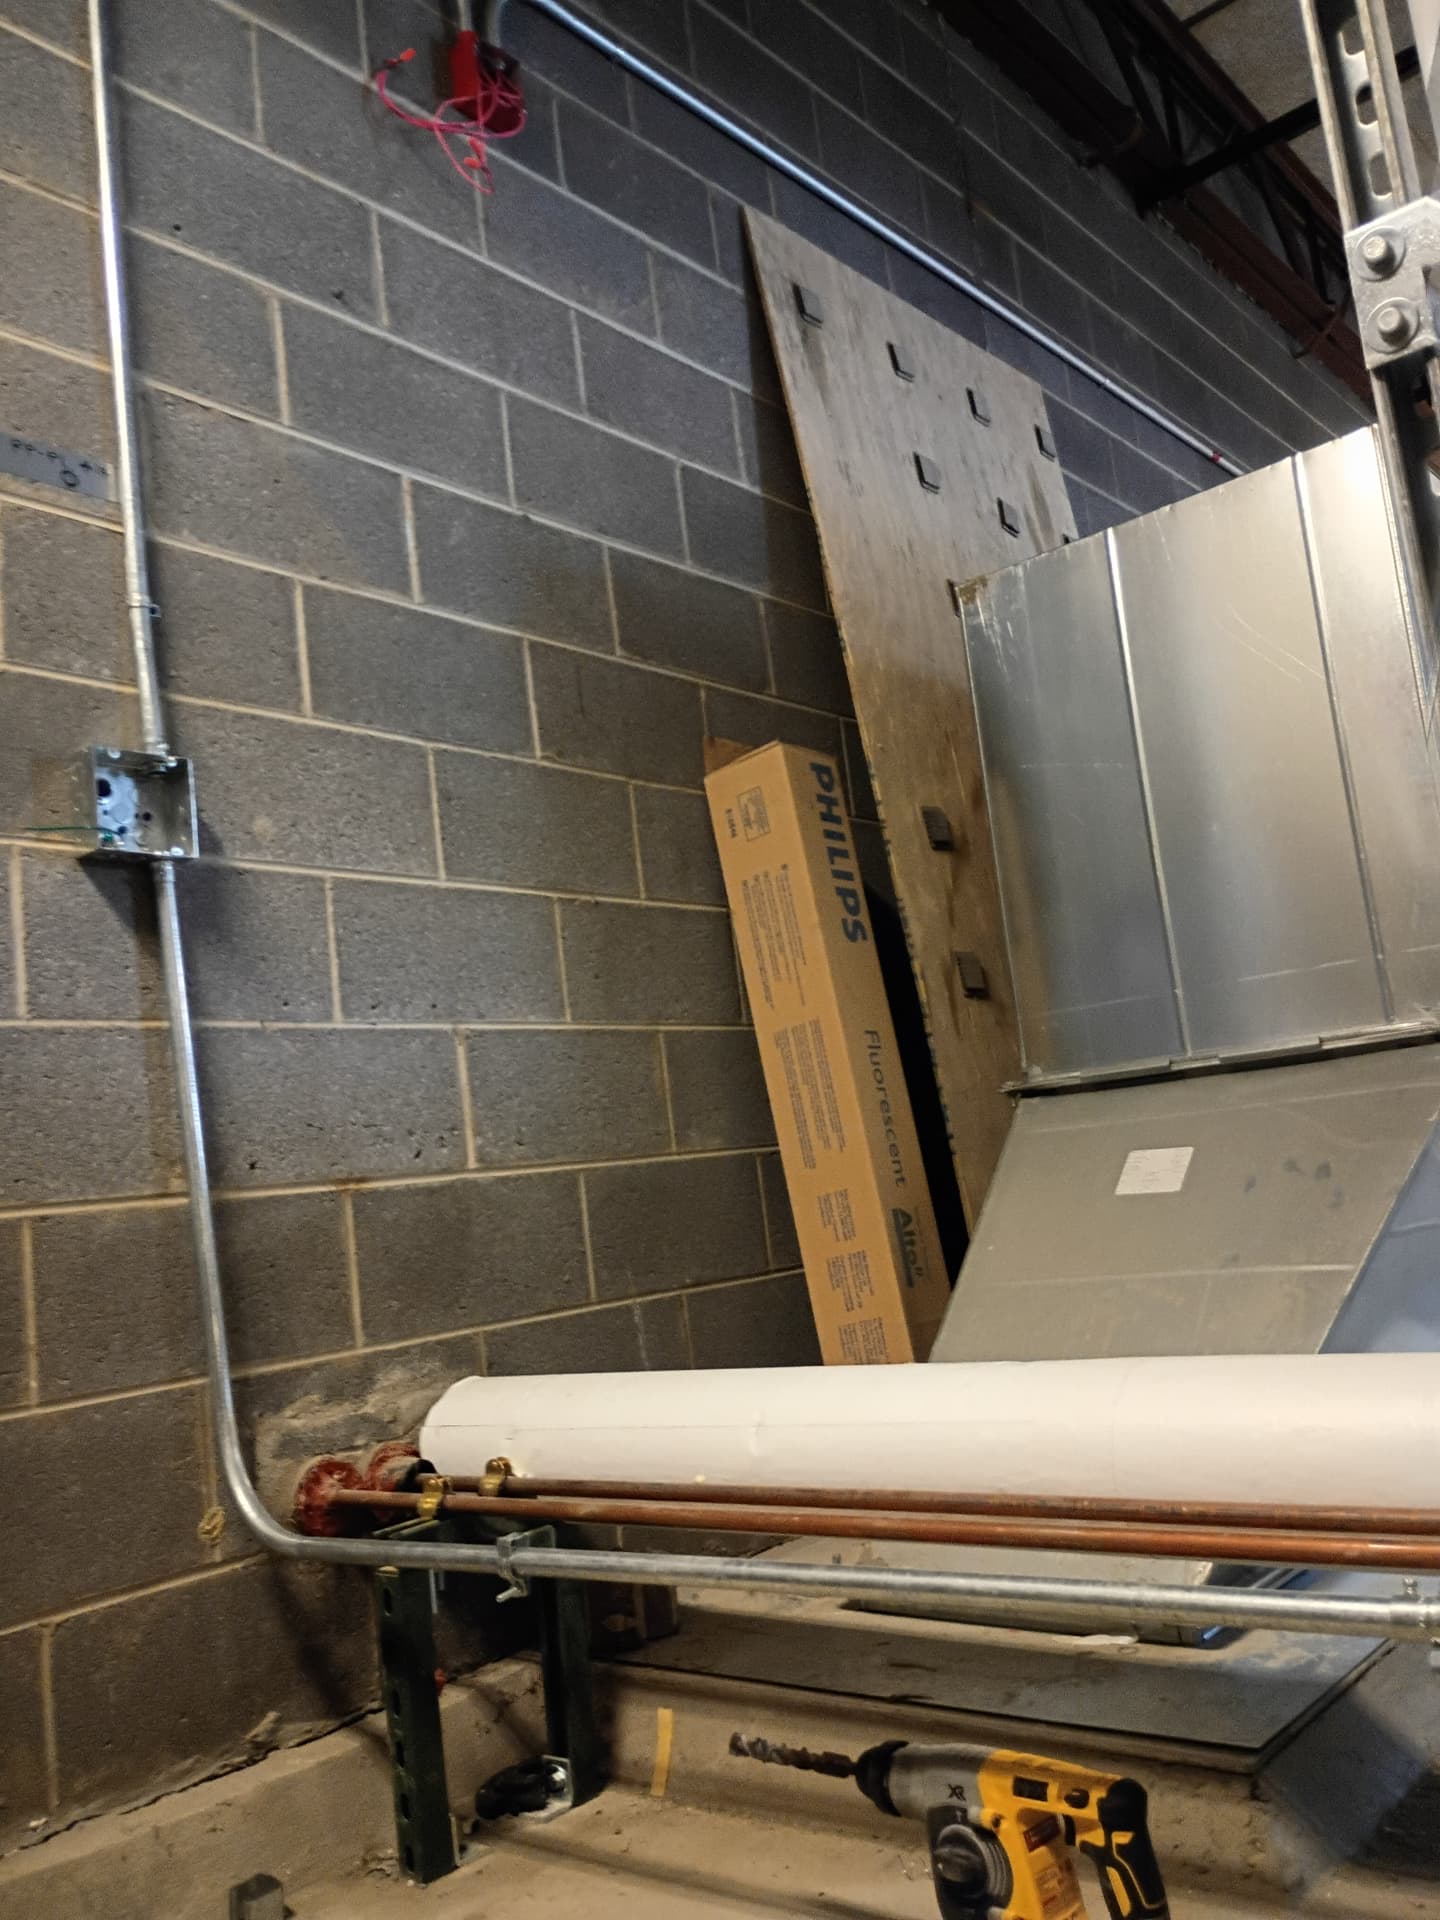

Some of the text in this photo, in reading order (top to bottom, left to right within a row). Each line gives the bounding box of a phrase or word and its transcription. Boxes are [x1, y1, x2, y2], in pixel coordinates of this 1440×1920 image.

[810, 762, 868, 943] PHILIPS
[864, 1029, 906, 1187] Fluorescent
[947, 1783, 967, 1801] XR
